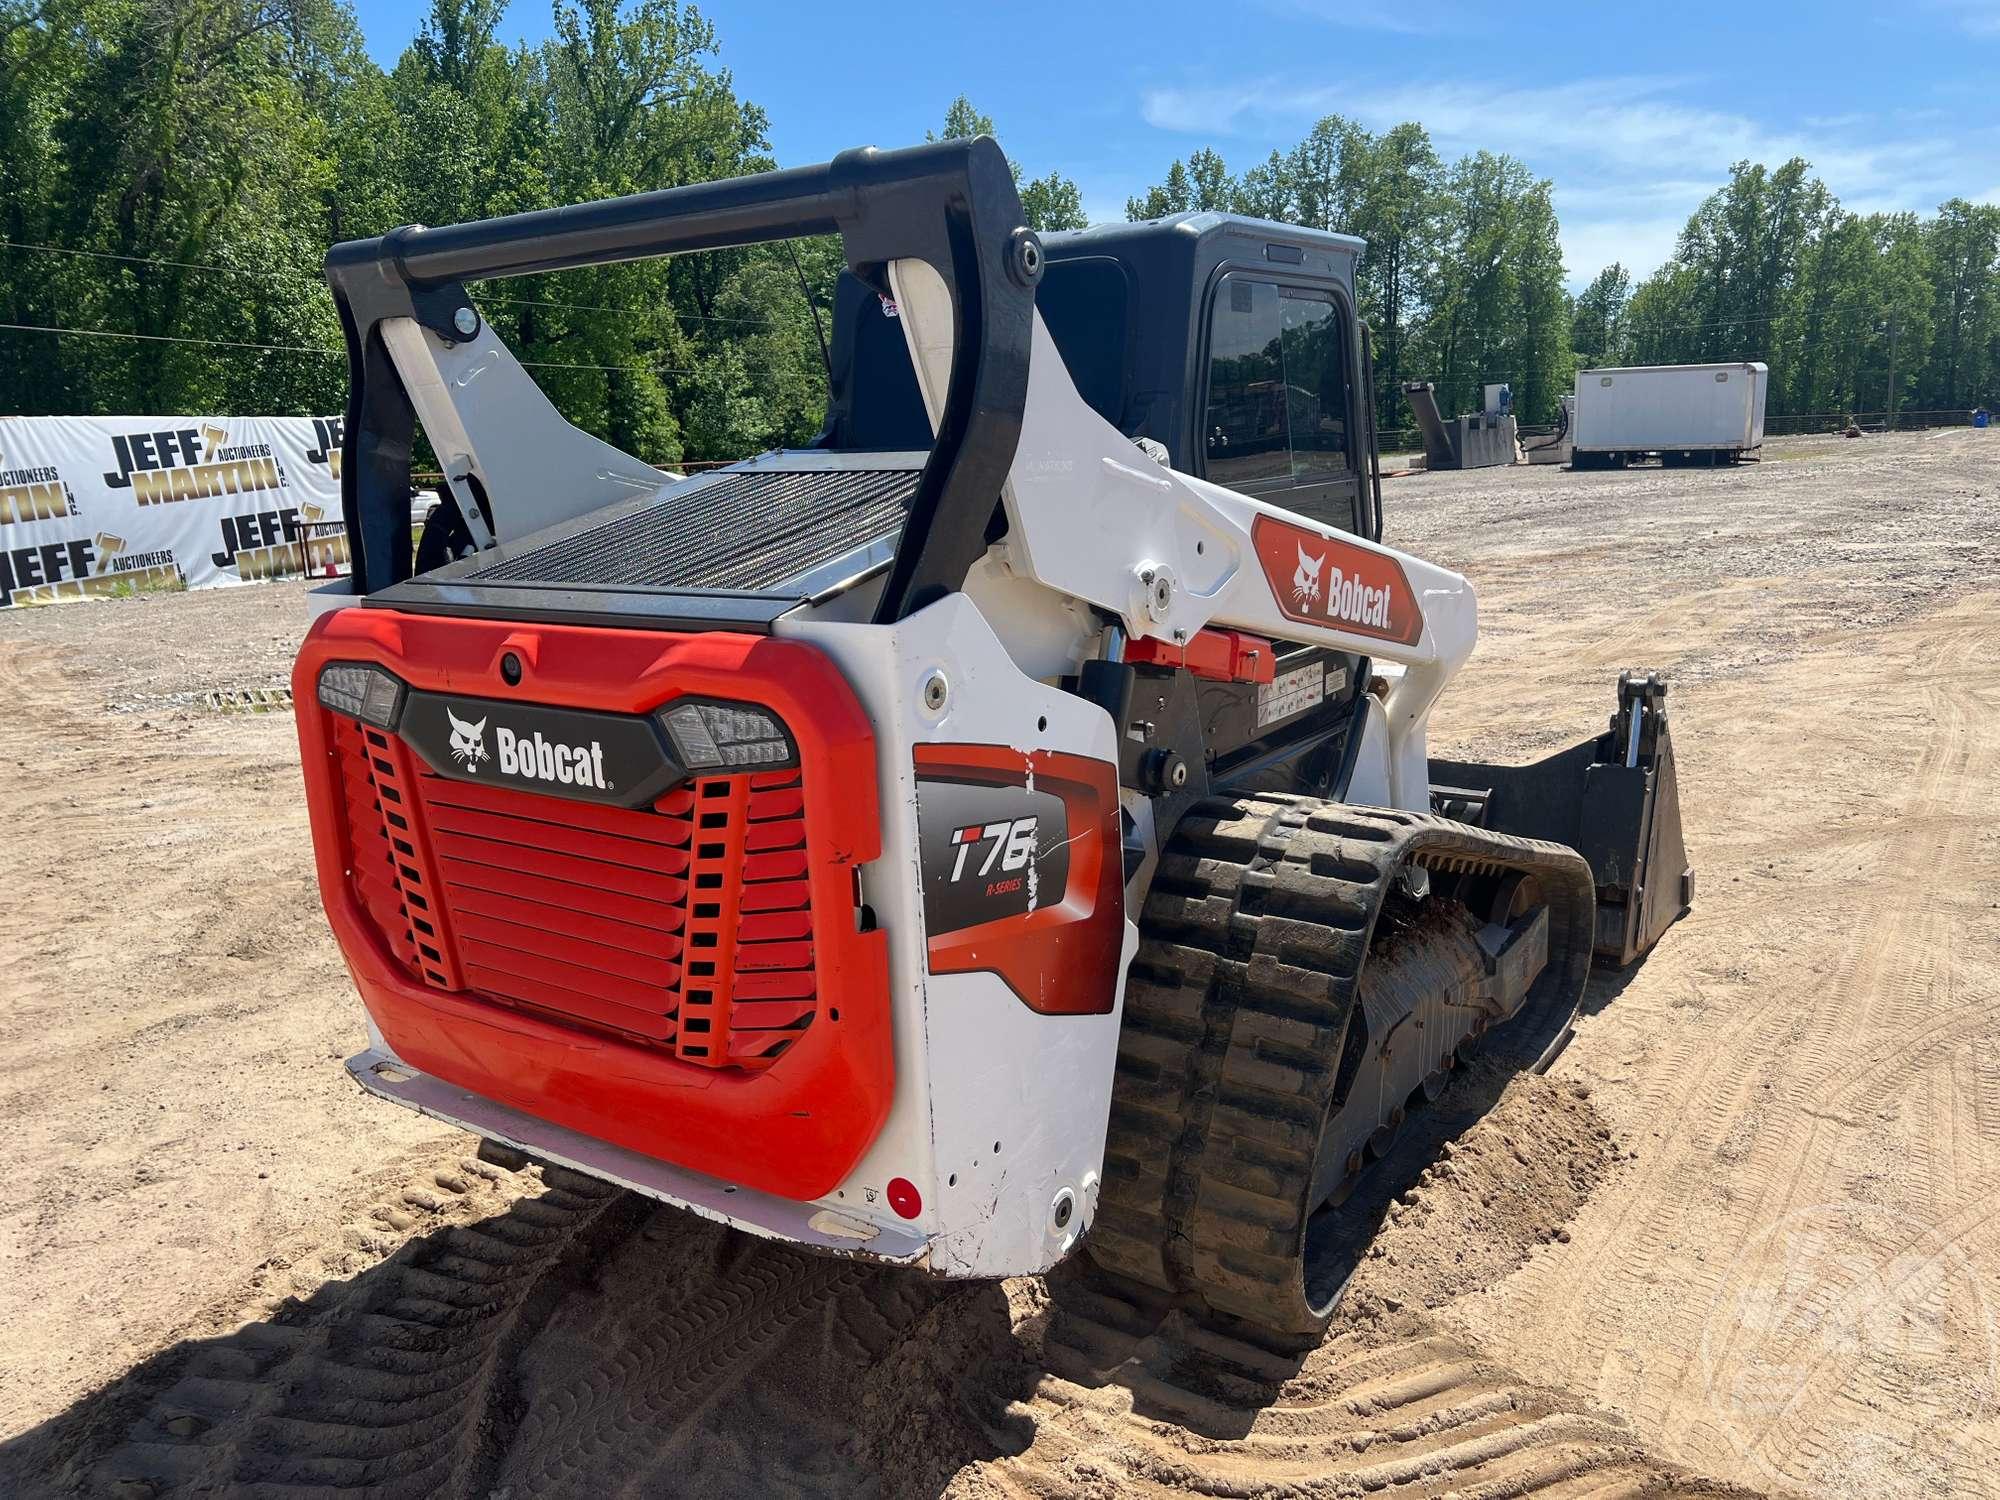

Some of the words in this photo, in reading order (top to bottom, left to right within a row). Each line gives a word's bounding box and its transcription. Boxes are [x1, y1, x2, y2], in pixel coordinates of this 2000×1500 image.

[103, 429, 203, 488] JEFF
[131, 458, 279, 507] MARTIN
[218, 444, 272, 462] AUCTIONEERS
[113, 550, 173, 572] AUCTIONEERS
[212, 508, 299, 567] JEFF
[1327, 567, 1391, 629] Bobcat
[496, 727, 606, 789] Bobcat
[951, 817, 1037, 882] T76
[986, 878, 1022, 896] R-SERIES
